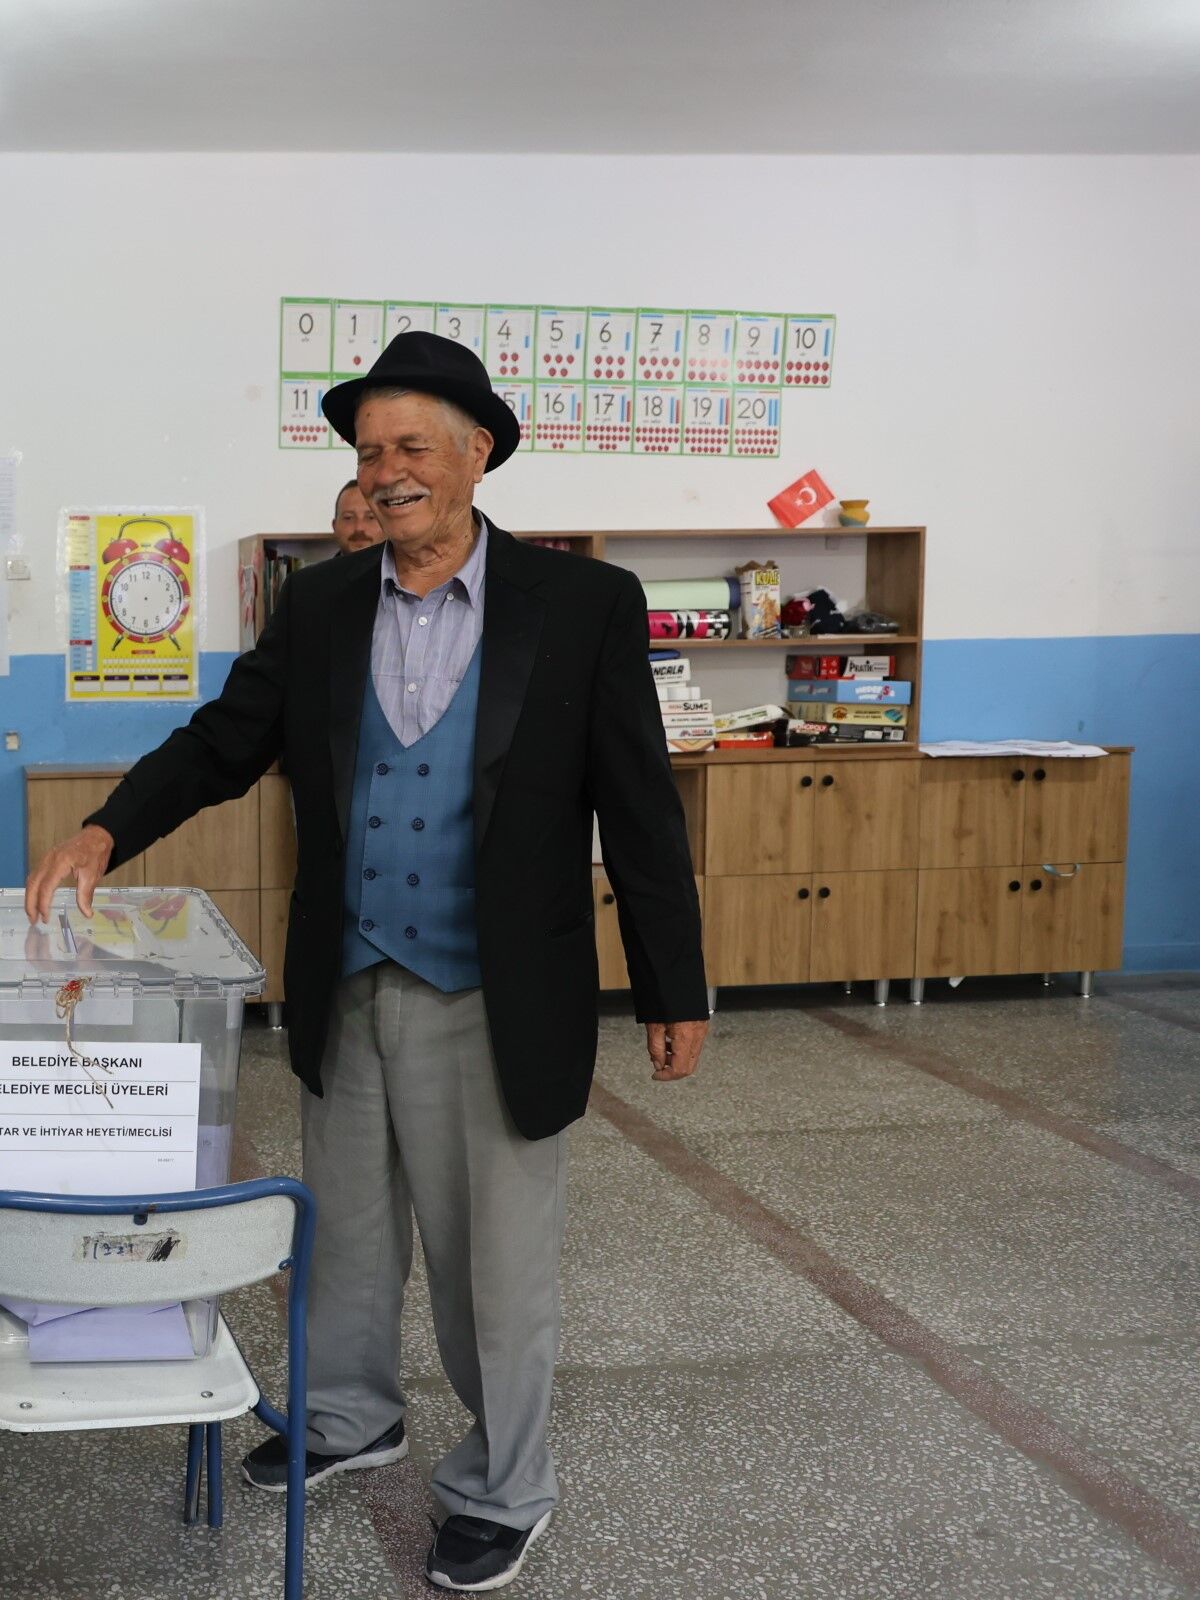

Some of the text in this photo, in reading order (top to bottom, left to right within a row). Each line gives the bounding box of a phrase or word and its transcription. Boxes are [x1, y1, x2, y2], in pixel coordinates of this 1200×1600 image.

[299, 313, 817, 349] 0 1 2 3 4 5 6 7 8 9 10
[292, 389, 309, 410] 11
[545, 392, 565, 414] 16
[594, 393, 615, 415] 17
[643, 395, 663, 417] 18
[693, 397, 712, 418] 19
[737, 398, 767, 419] 20
[142, 571, 151, 580] 12
[121, 584, 129, 592] 10
[165, 583, 171, 591] 2
[131, 616, 136, 624] 7
[143, 619, 149, 628] 6
[155, 616, 160, 624] 5
[12, 1054, 142, 1070] BELEDİYE BAŞKANI
[54, 1082, 108, 1095] MECLİSİ
[111, 1083, 169, 1096] ÜYELERİ
[22, 1127, 37, 1137] VE
[40, 1125, 84, 1137] İHTİYAR
[86, 1125, 172, 1138] HEYETİ/MECLİSİ
